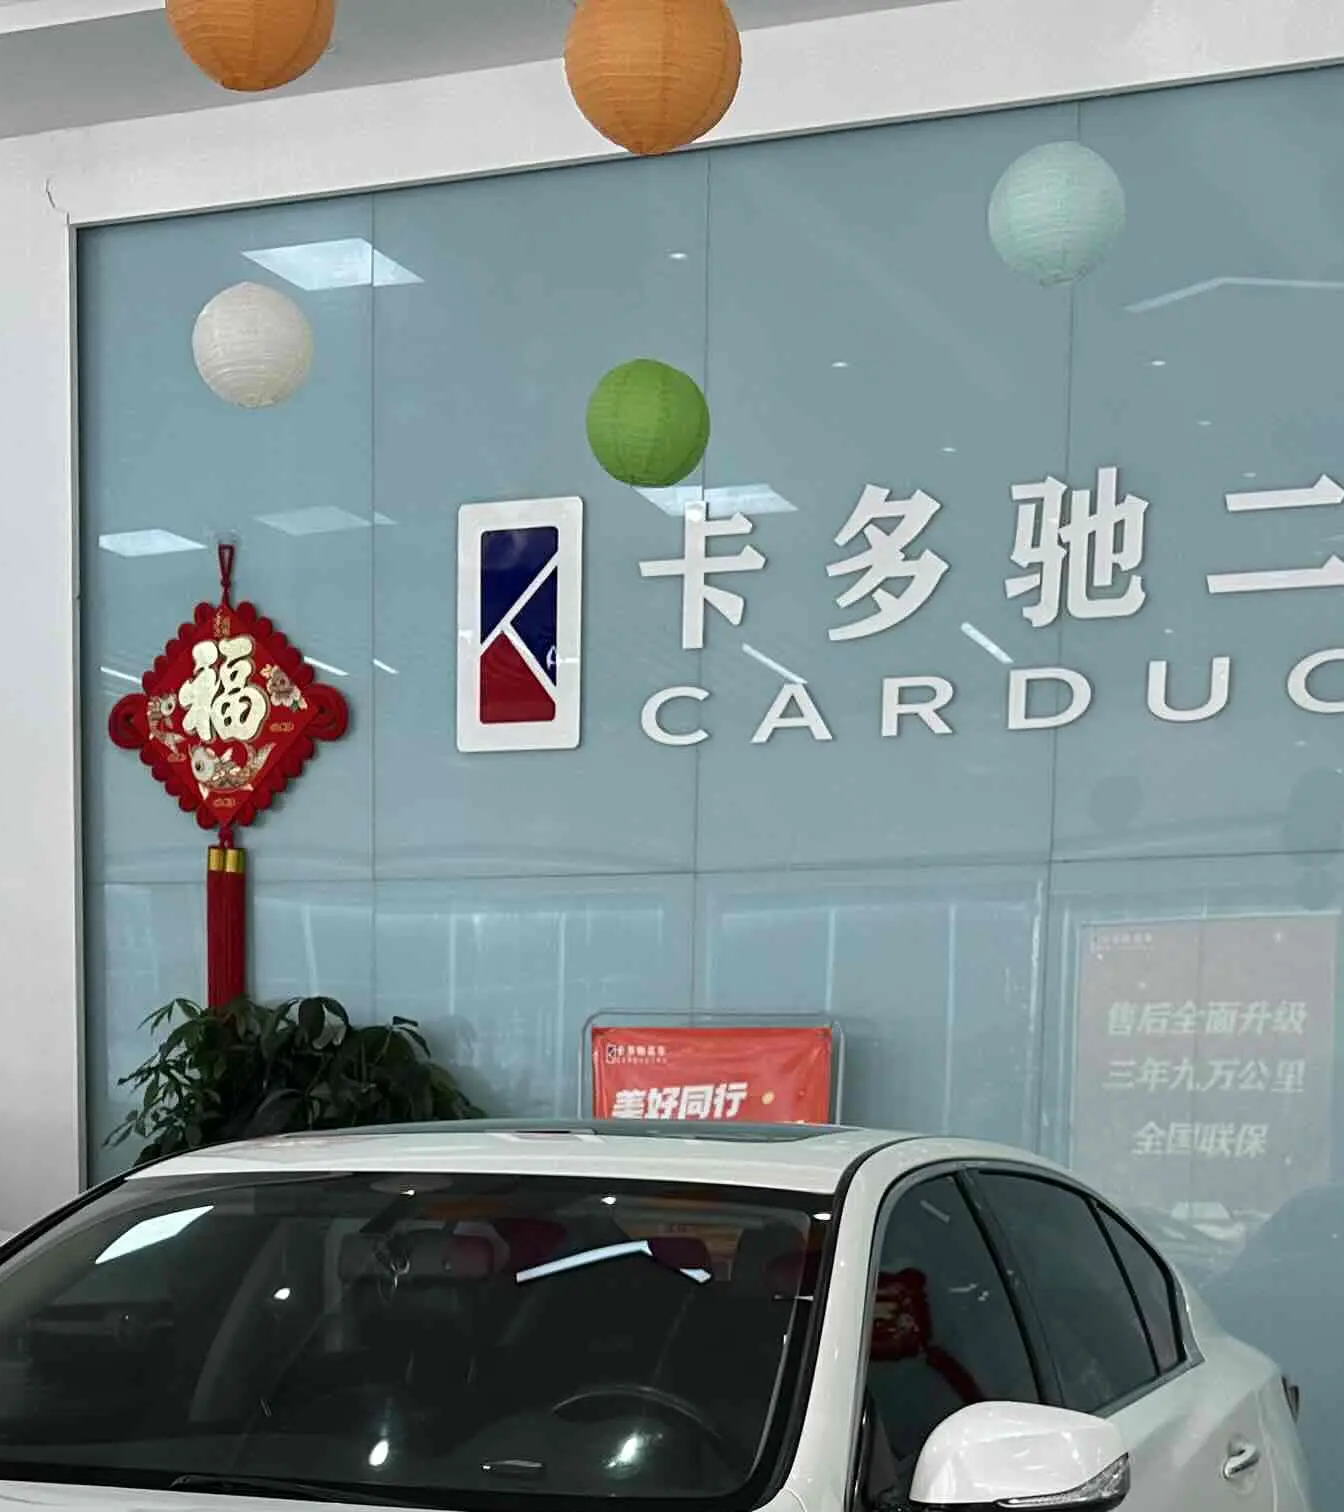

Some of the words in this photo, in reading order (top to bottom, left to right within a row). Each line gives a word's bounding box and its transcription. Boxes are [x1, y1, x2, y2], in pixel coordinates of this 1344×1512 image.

[177, 634, 270, 743] 福
[1108, 1000, 1309, 1036] 售后全面升级
[1102, 1057, 1306, 1093] 三年九万公里
[1131, 1120, 1270, 1158] 全国联保
